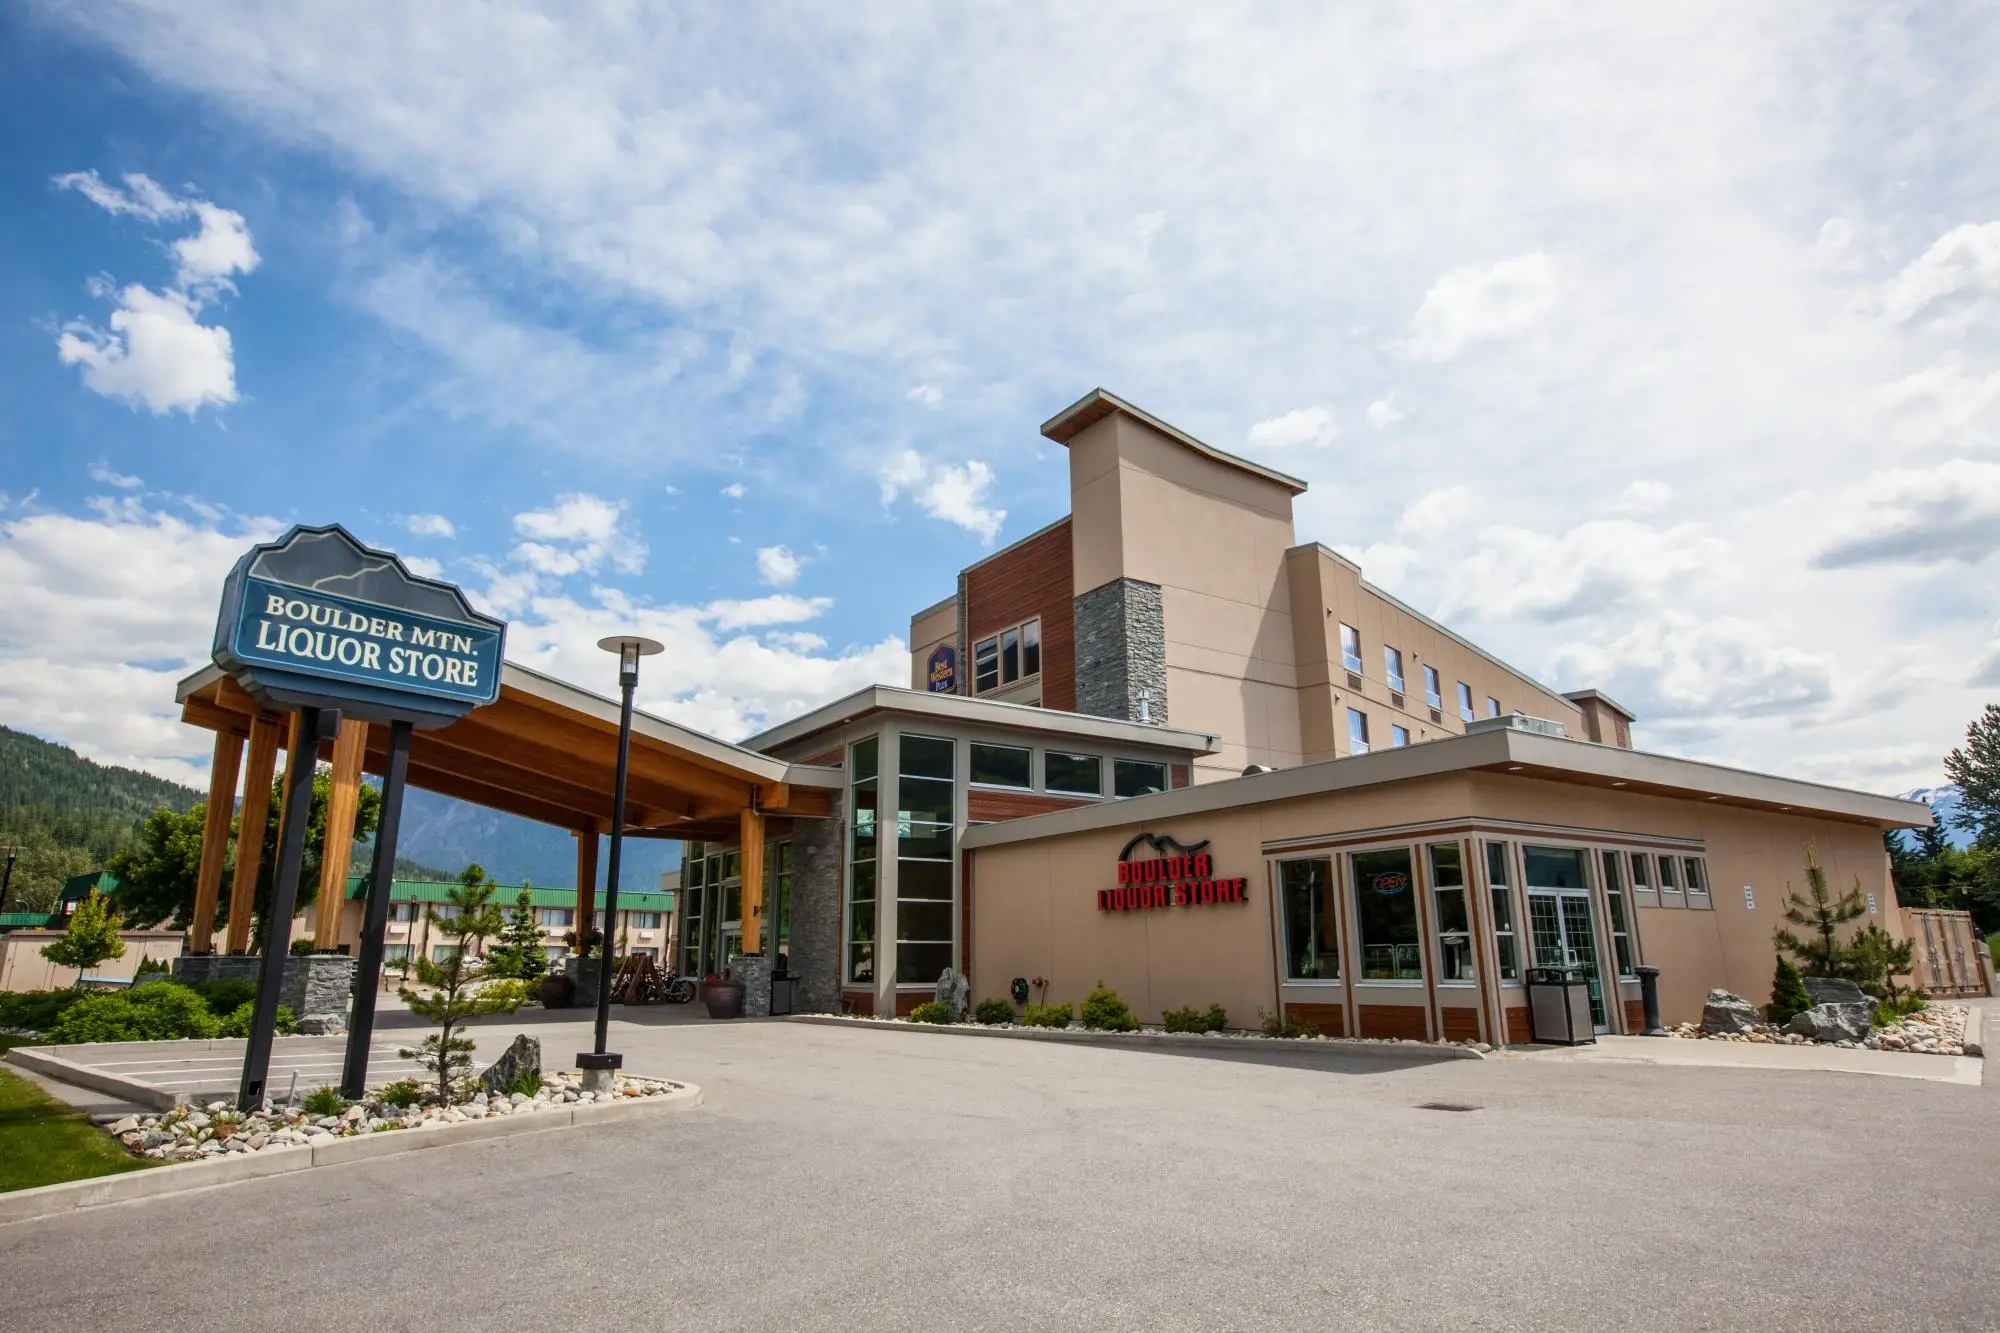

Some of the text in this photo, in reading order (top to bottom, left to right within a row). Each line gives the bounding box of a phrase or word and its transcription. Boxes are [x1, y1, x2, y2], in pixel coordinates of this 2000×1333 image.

[265, 594, 479, 656] BOULDER MTN.
[256, 620, 478, 687] LIQUOR STORE
[1117, 853, 1213, 884] BOULDER
[1097, 877, 1249, 911] LIQUOR STORE
